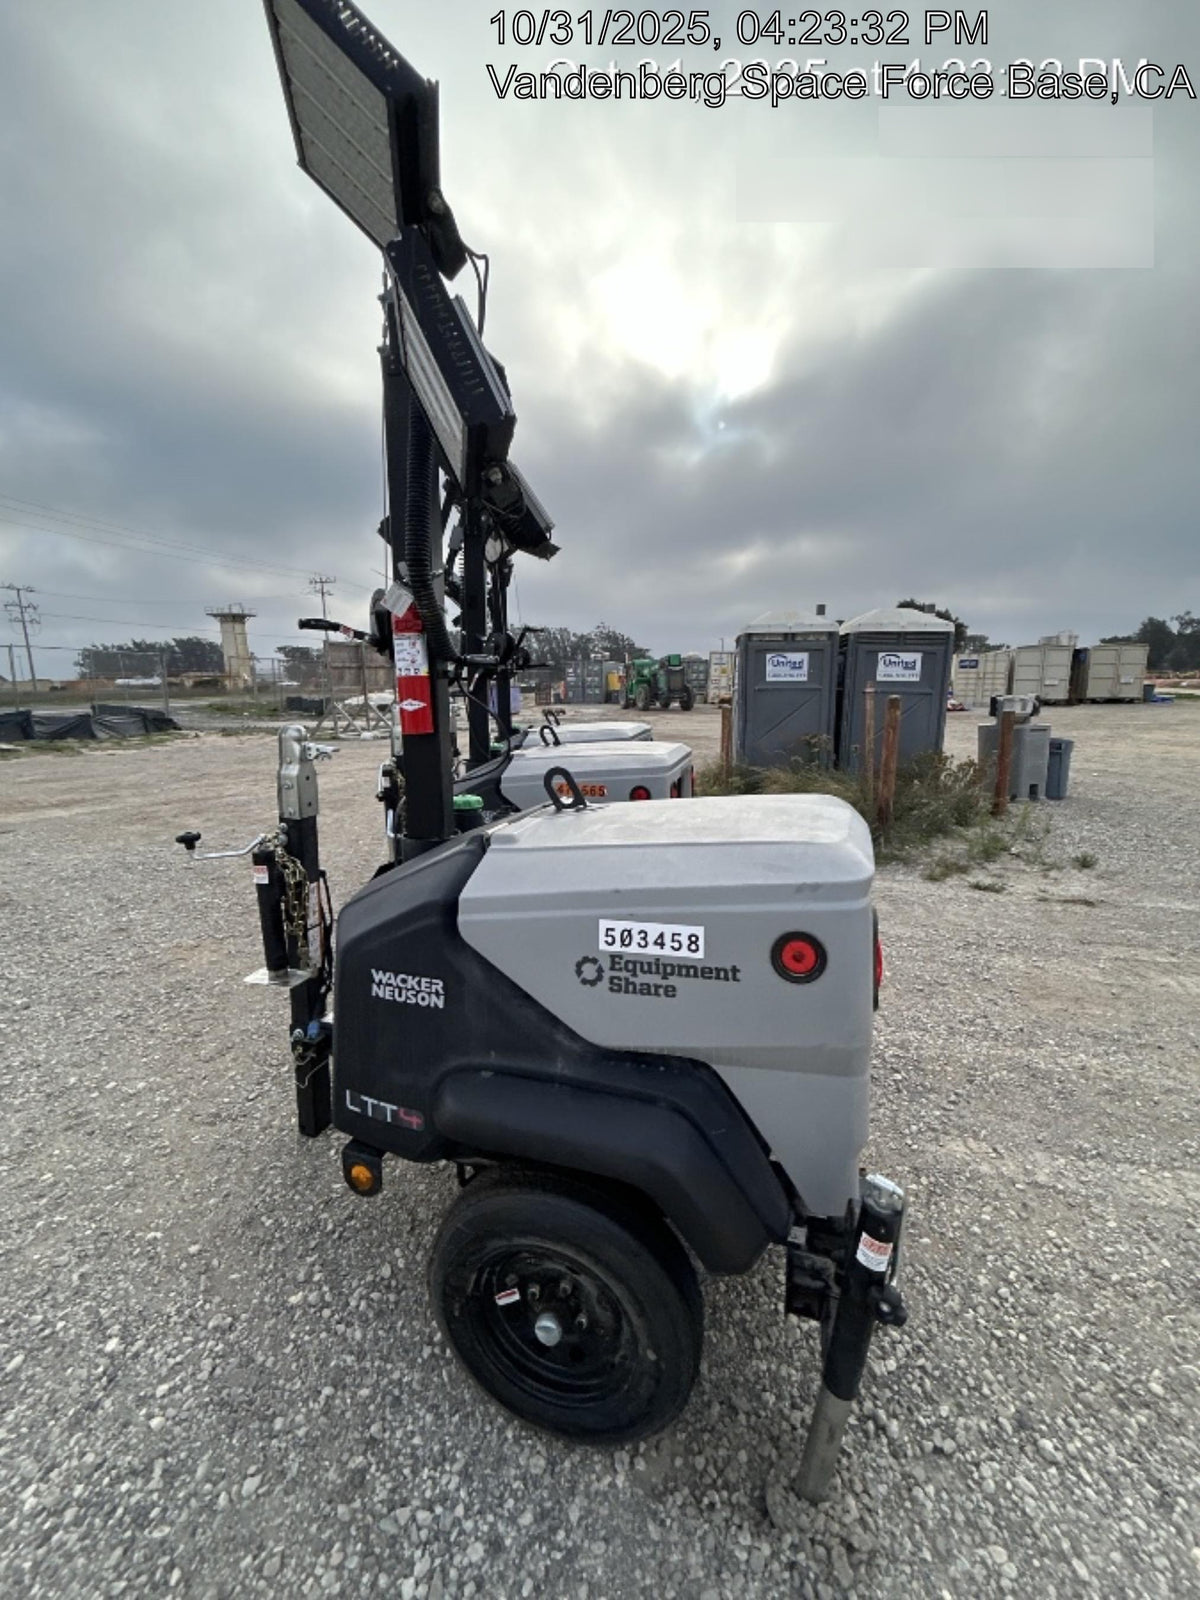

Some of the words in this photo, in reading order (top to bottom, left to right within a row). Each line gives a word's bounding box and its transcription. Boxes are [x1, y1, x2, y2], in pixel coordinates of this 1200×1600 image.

[603, 926, 701, 954] 503458
[370, 968, 445, 995] WACKER
[608, 954, 741, 983] Equipment
[371, 984, 446, 1009] NEUSON
[608, 976, 678, 999] Share
[345, 1088, 423, 1130] LTT4
